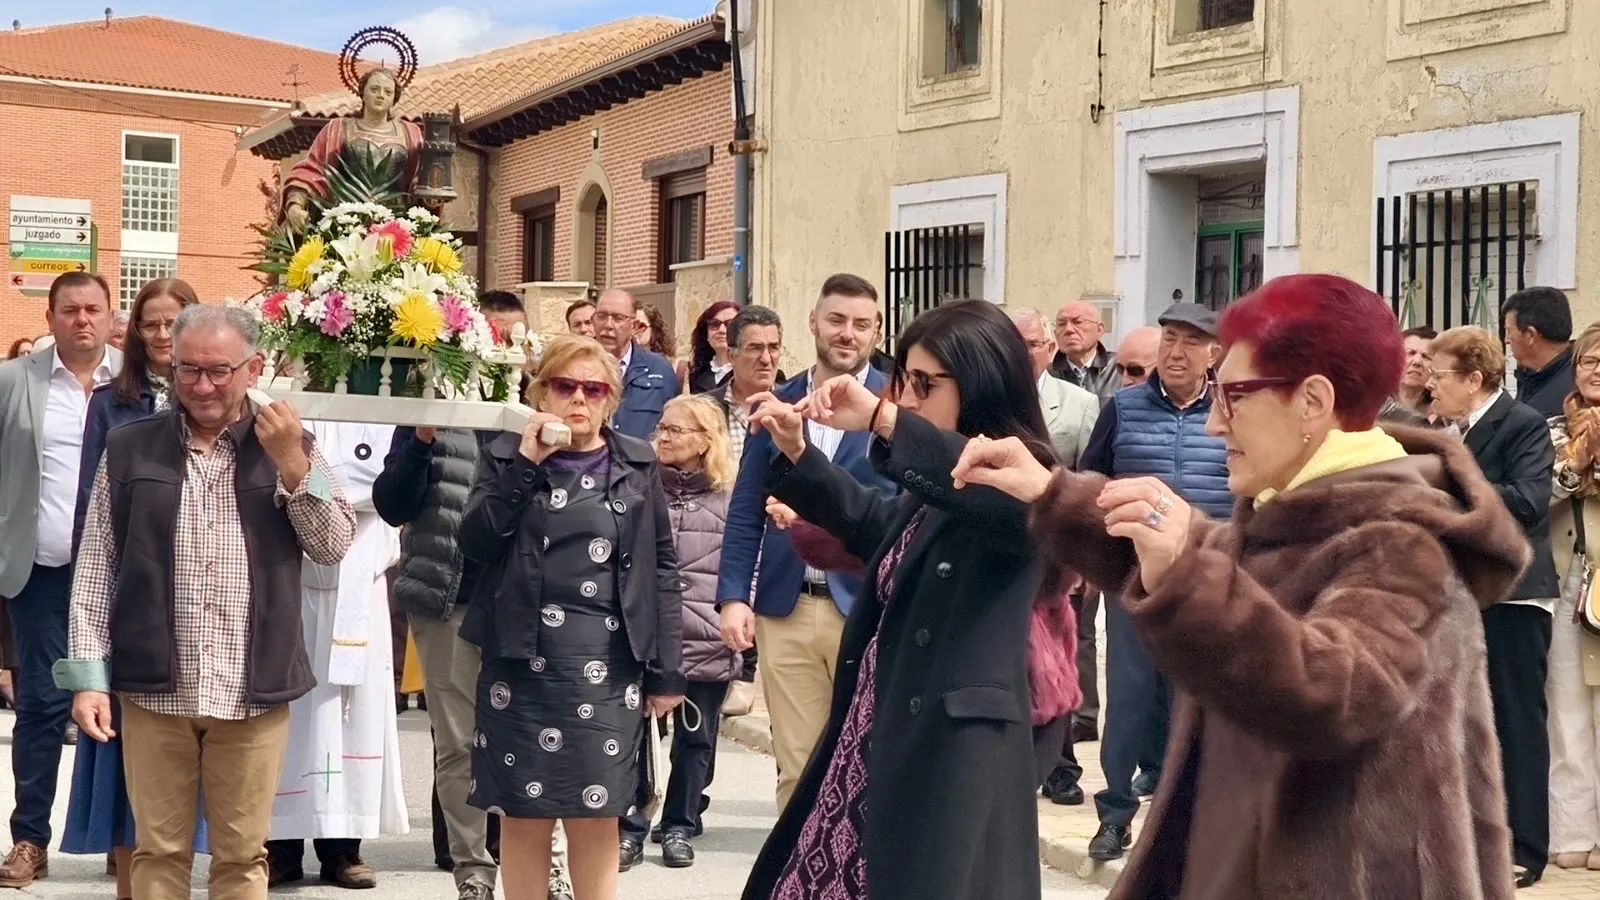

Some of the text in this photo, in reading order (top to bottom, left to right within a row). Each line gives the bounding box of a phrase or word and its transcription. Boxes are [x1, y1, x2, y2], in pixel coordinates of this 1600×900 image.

[12, 214, 73, 225] ayuntamiento
[24, 229, 61, 240] juzgado
[30, 262, 69, 271] correos
